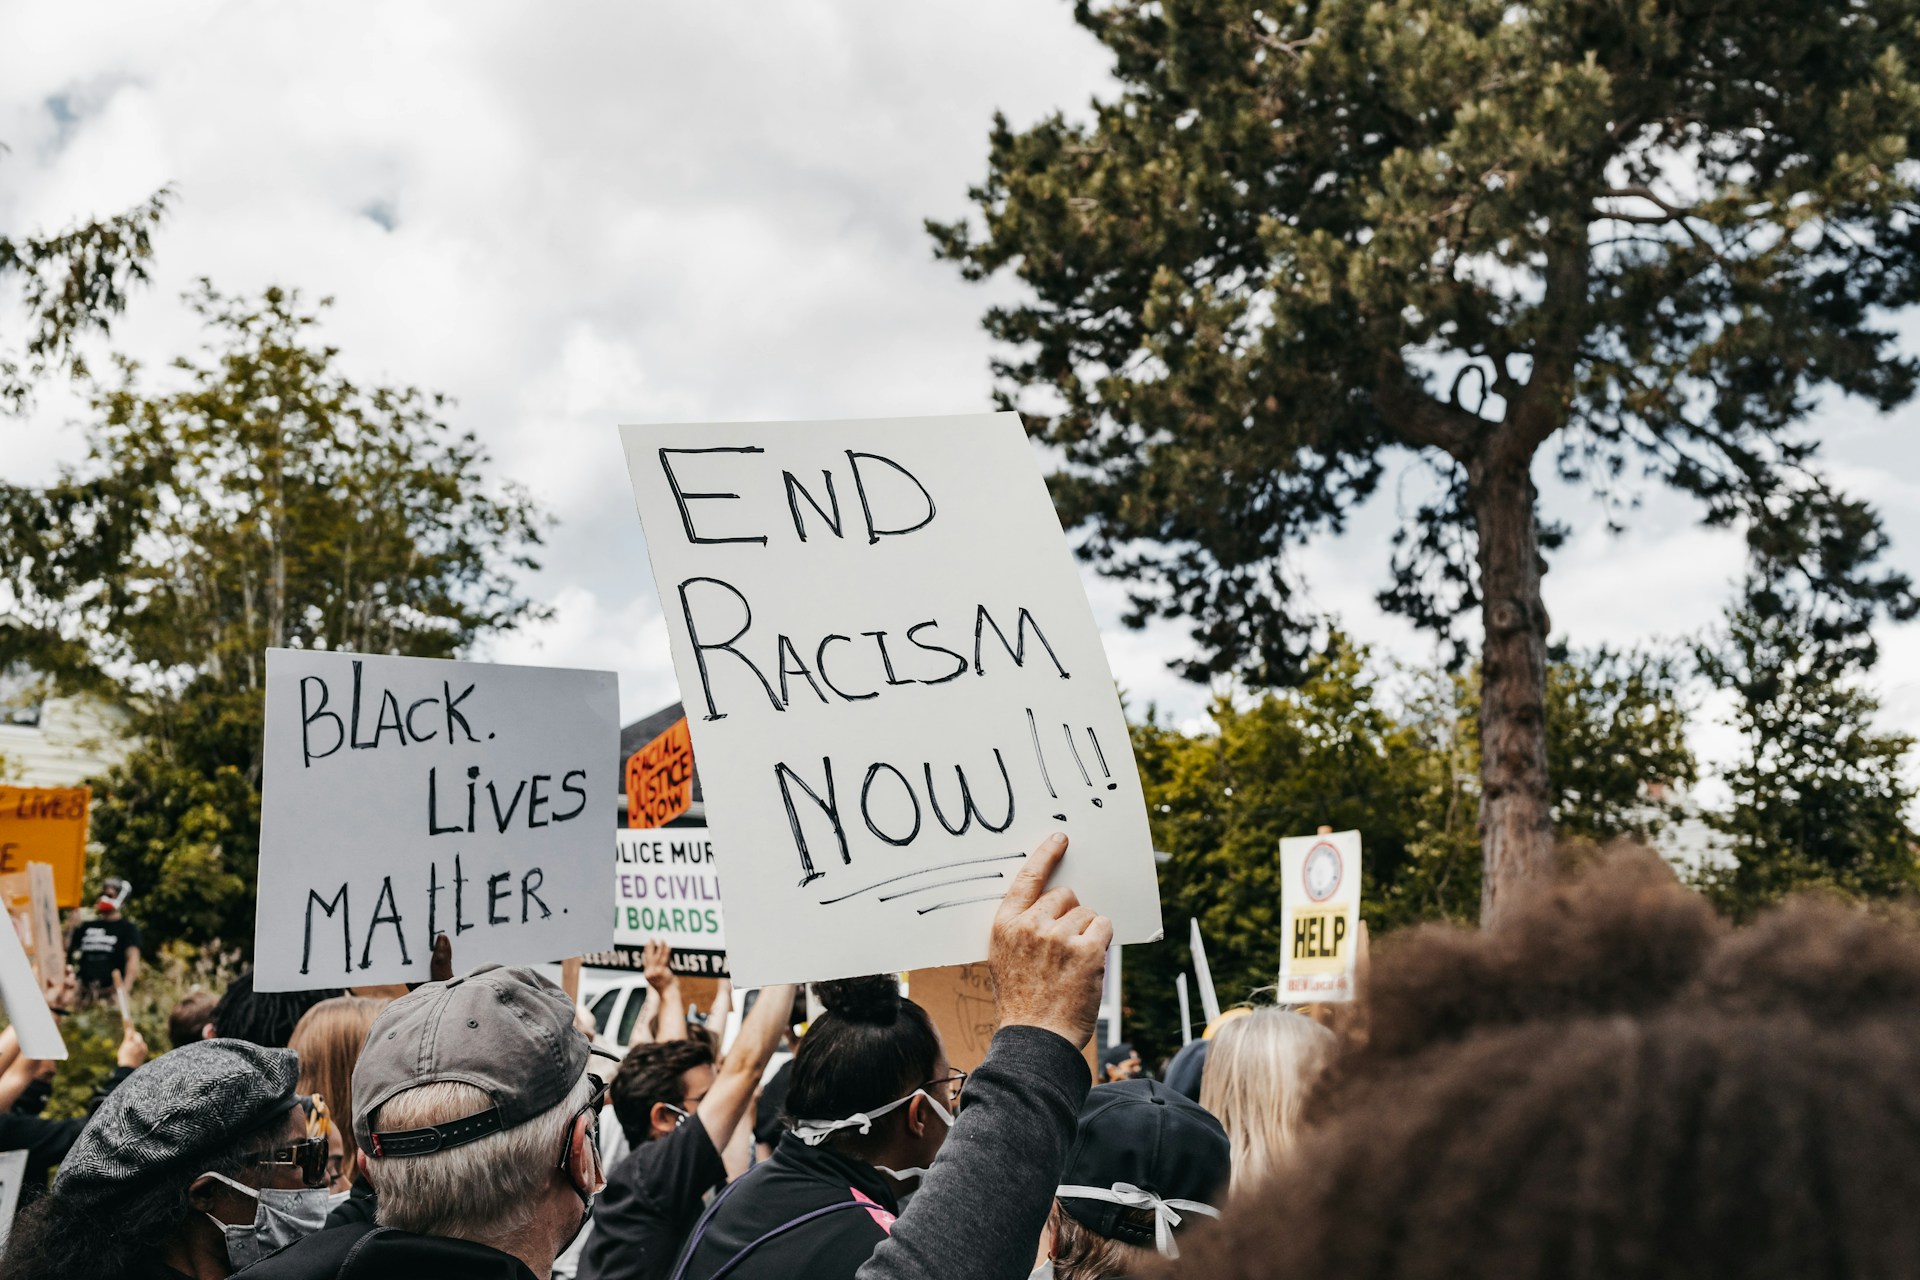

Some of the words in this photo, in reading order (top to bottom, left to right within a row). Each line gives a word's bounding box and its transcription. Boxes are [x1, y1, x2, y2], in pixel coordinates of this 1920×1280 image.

[657, 445, 936, 546] END
[676, 576, 1071, 721] RACISM
[300, 660, 495, 768] BLACK.
[645, 793, 682, 828] NOW
[616, 841, 664, 864] LICE
[617, 874, 648, 898] ED
[626, 906, 719, 934] BOARDS
[1293, 916, 1345, 959] HELP
[581, 950, 630, 967] EEDOM
